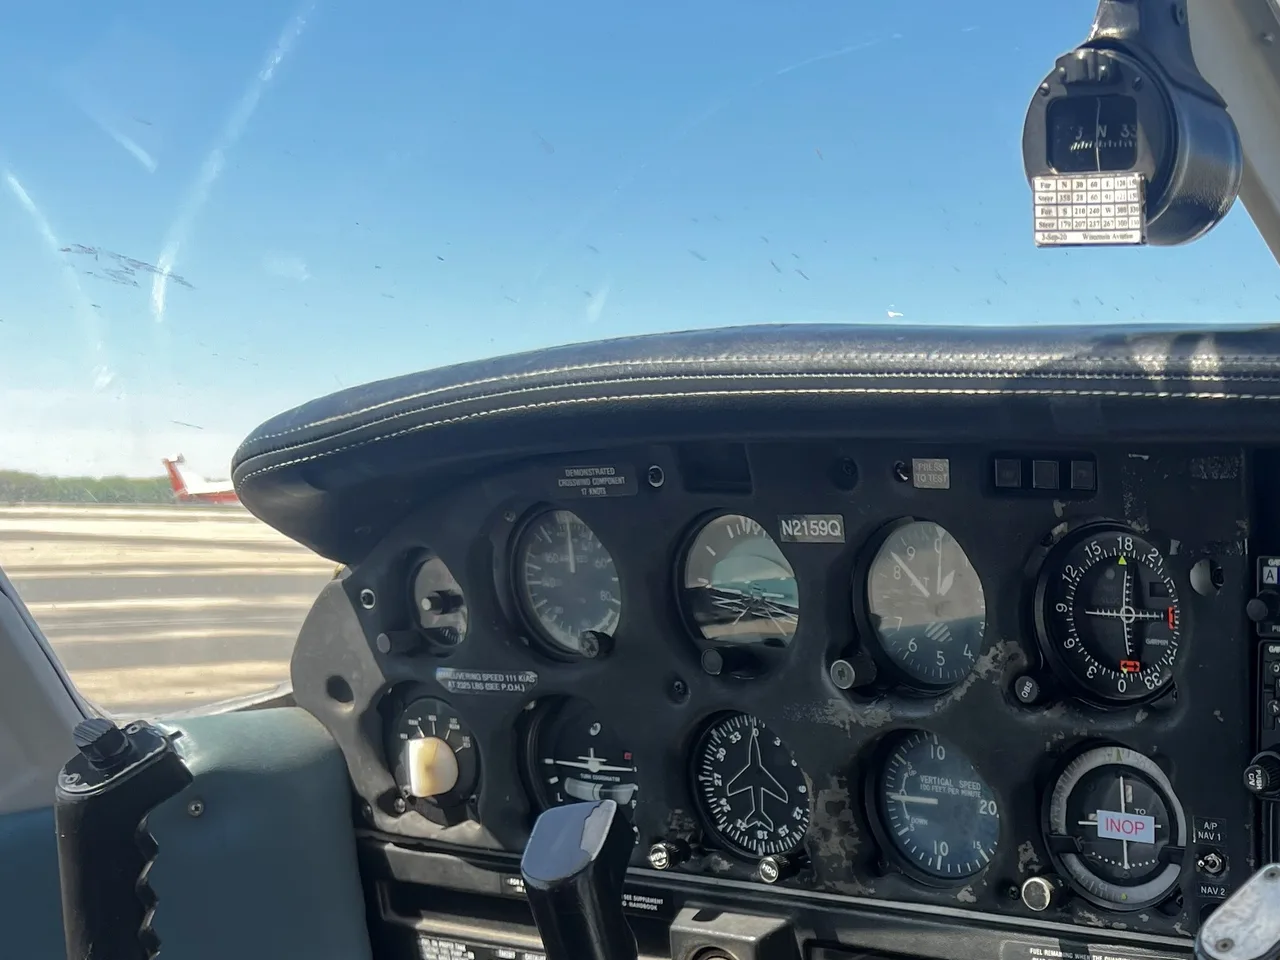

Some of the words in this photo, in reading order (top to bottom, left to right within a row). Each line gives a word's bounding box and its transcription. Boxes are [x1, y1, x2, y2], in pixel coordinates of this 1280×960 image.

[565, 467, 615, 477] DEMONSTRATED
[918, 463, 944, 472] PRESS
[916, 473, 927, 482] TO
[928, 474, 947, 483] TEST
[782, 520, 841, 536] N2159Q
[1084, 541, 1102, 558] 15
[1117, 537, 1134, 551] 18
[1148, 550, 1163, 566] 21
[1062, 565, 1078, 583] 12
[909, 638, 918, 652] 6
[936, 651, 945, 666] 5
[1144, 672, 1163, 690] 33
[1020, 681, 1033, 698] OBS
[930, 745, 946, 760] 10
[920, 775, 953, 788] VERTICAL
[959, 780, 981, 790] SPEED
[979, 800, 997, 815] 20
[1105, 817, 1145, 835] INOP
[1203, 822, 1217, 830] A/P
[1198, 831, 1215, 840] NAV
[1217, 833, 1221, 841] 1
[933, 840, 949, 856] 10
[1200, 886, 1217, 894] NAV
[1219, 888, 1226, 896] 2
